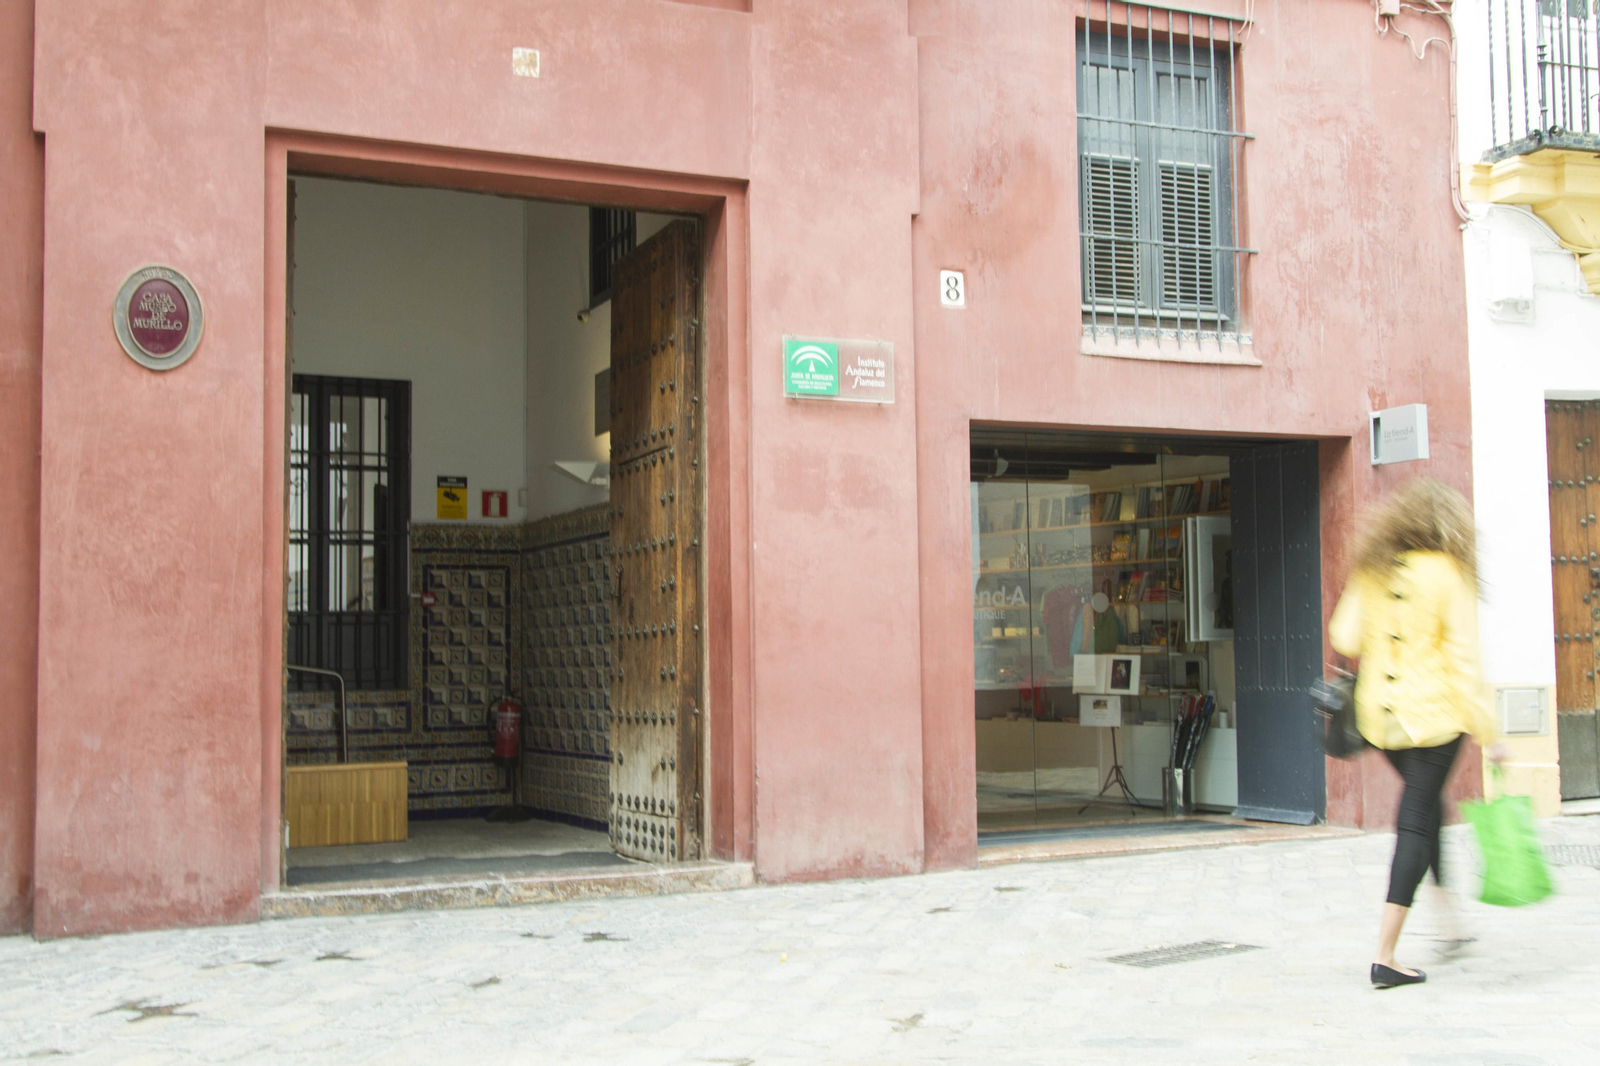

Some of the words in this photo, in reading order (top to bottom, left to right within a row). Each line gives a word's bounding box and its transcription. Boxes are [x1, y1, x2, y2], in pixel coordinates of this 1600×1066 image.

[946, 275, 960, 301] 8
[142, 291, 173, 304] CASA
[138, 300, 177, 313] MUSEO
[151, 311, 167, 321] DE
[133, 317, 183, 331] MURILLO
[857, 355, 885, 368] Instituto
[845, 364, 874, 378] Andaluz
[875, 368, 886, 378] del
